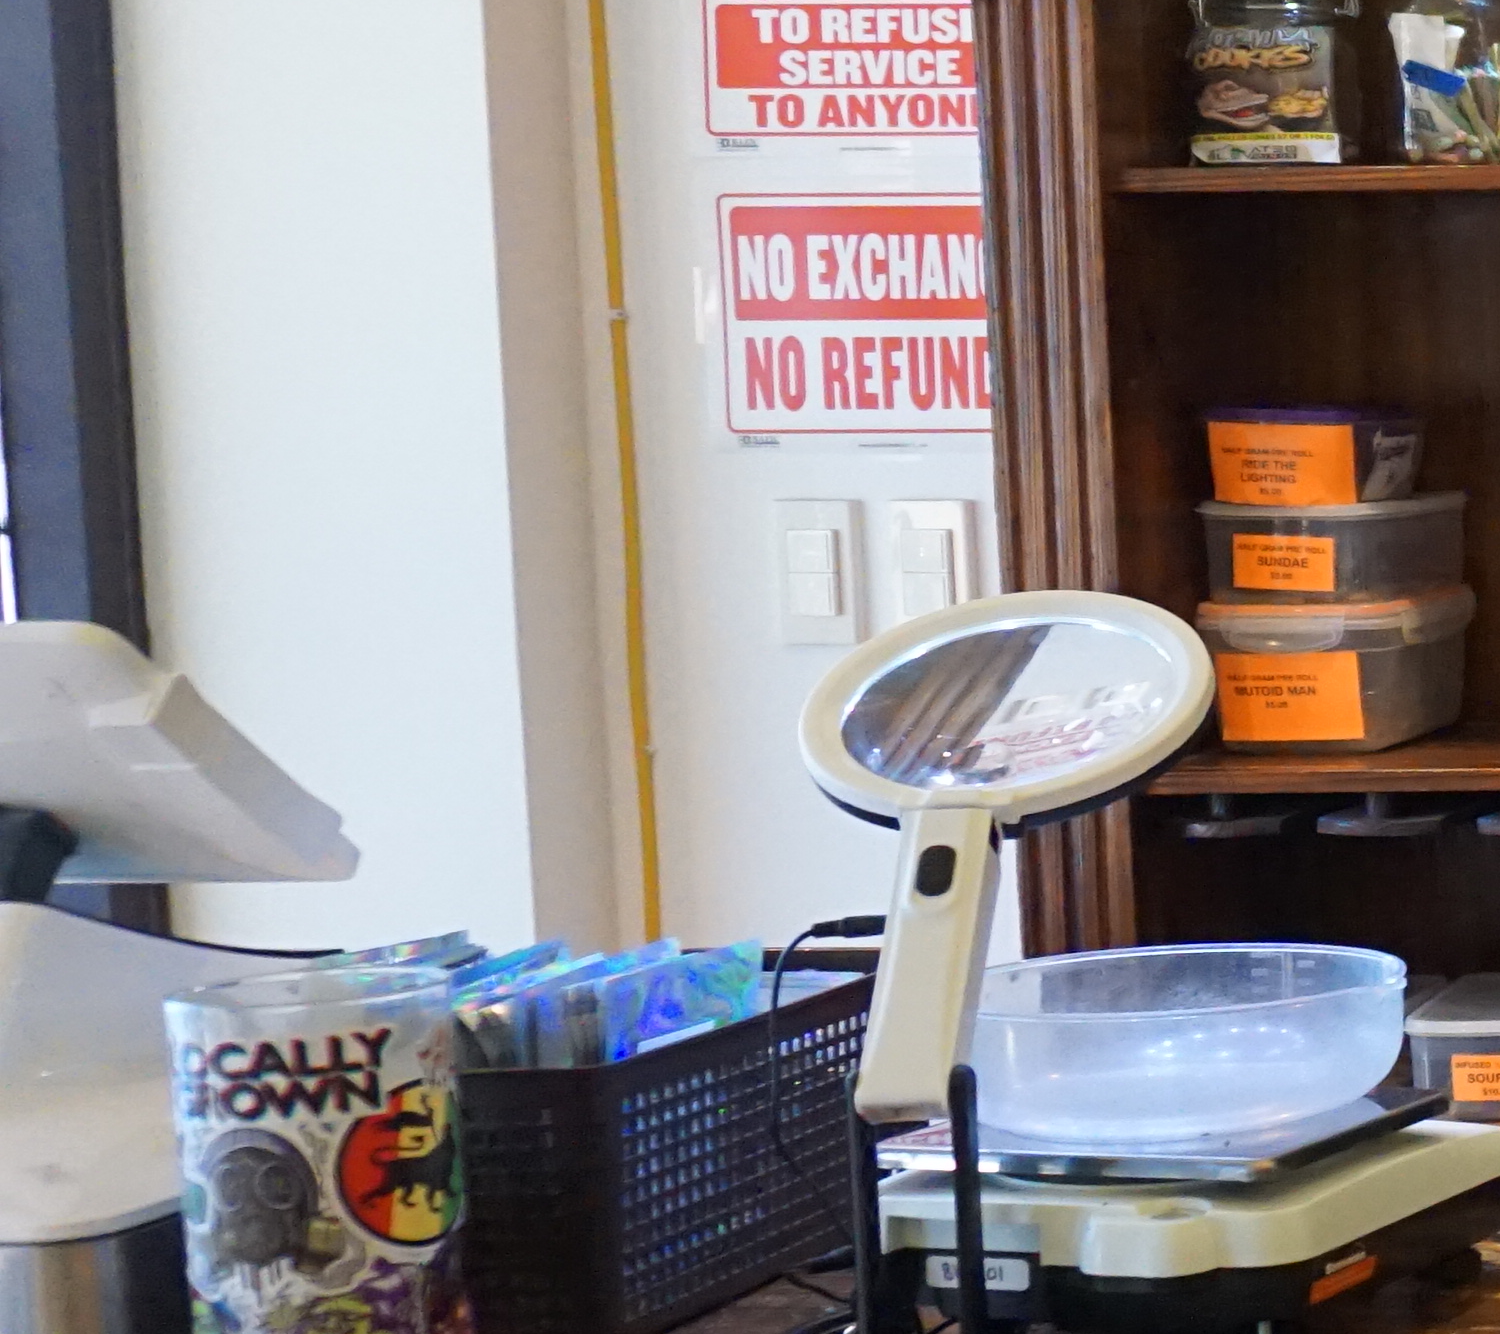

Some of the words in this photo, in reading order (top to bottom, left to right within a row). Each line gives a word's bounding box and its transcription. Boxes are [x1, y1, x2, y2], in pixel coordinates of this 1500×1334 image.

[751, 8, 811, 44] TO
[778, 49, 962, 85] SERVICE
[748, 94, 805, 128] TO
[737, 233, 796, 302] NO
[806, 232, 986, 301] EXCHAN
[744, 335, 807, 412] NO
[1240, 472, 1298, 485] LIGHTING
[1273, 460, 1298, 471] THE
[1256, 556, 1310, 569] SUNDAE
